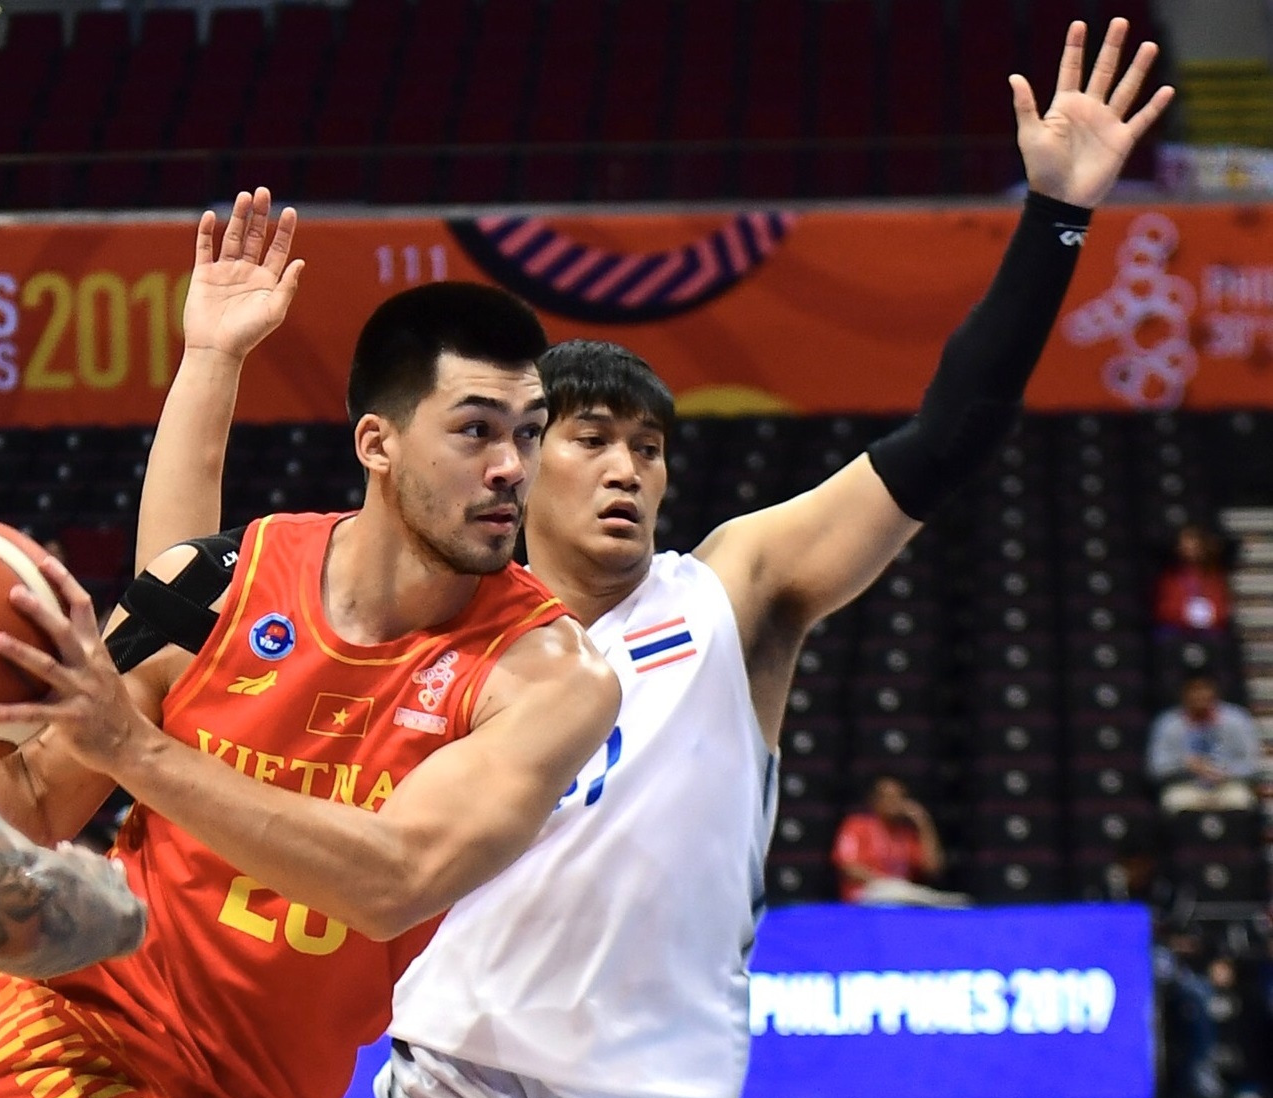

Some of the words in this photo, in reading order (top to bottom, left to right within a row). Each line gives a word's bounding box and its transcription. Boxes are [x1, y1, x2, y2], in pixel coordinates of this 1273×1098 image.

[24, 271, 184, 390] 201
[196, 727, 395, 812] VIETNA
[749, 971, 1006, 1035] PHILIPPINES
[1011, 967, 1116, 1034] 2019
